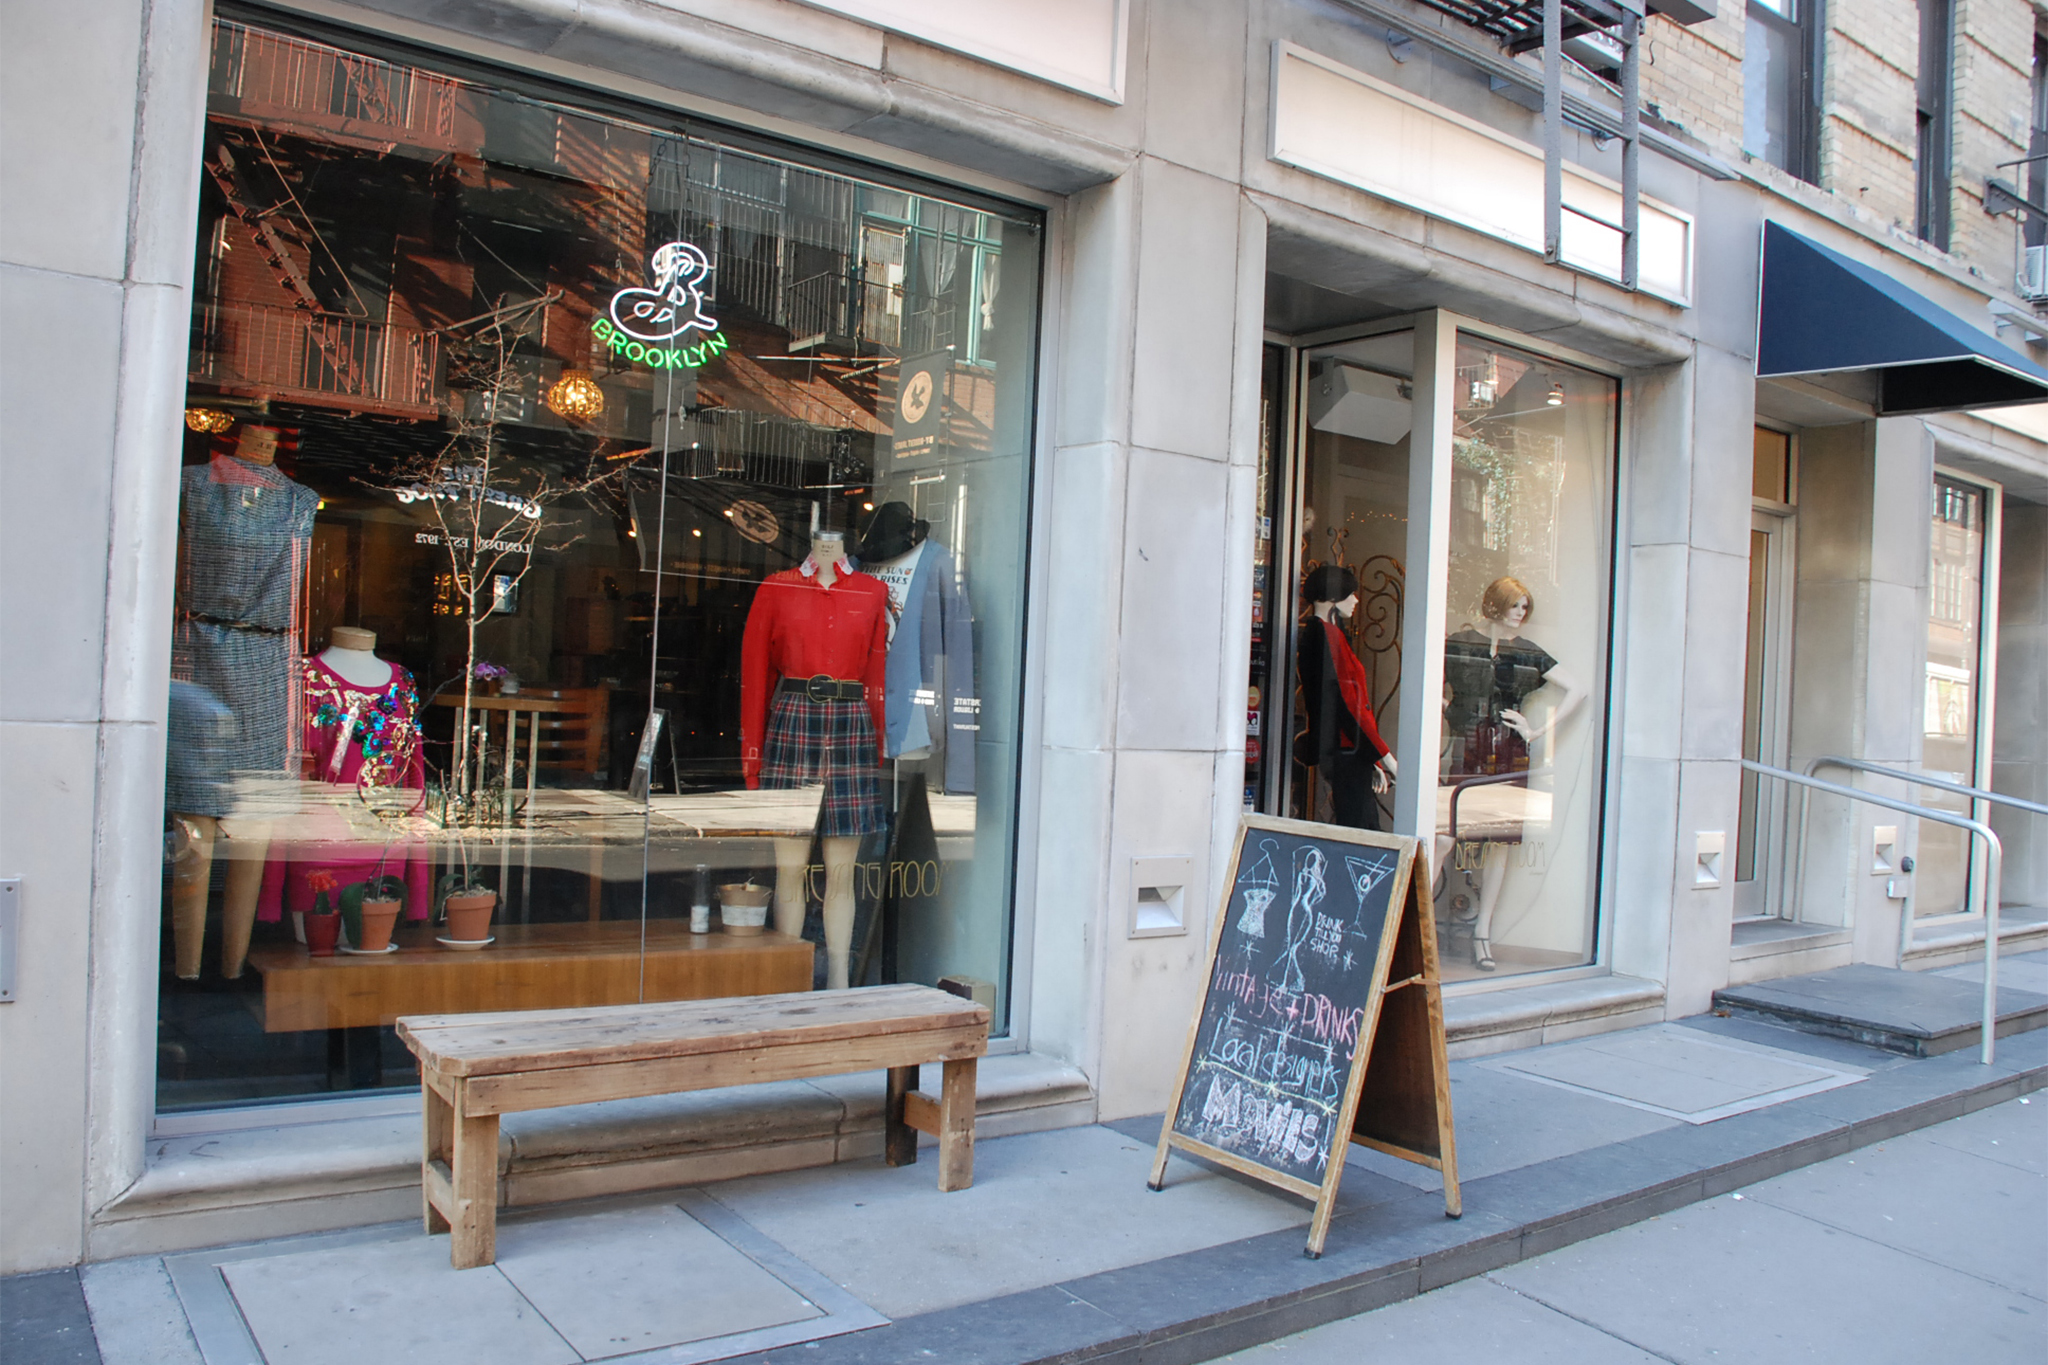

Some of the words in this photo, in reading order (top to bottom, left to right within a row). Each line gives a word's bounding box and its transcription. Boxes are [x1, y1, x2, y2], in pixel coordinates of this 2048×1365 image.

[591, 317, 728, 370] BROOKLYN
[880, 575, 908, 585] RISES
[885, 566, 903, 575] SUN
[1316, 911, 1344, 933] DRINK
[1209, 1017, 1263, 1077] Local
